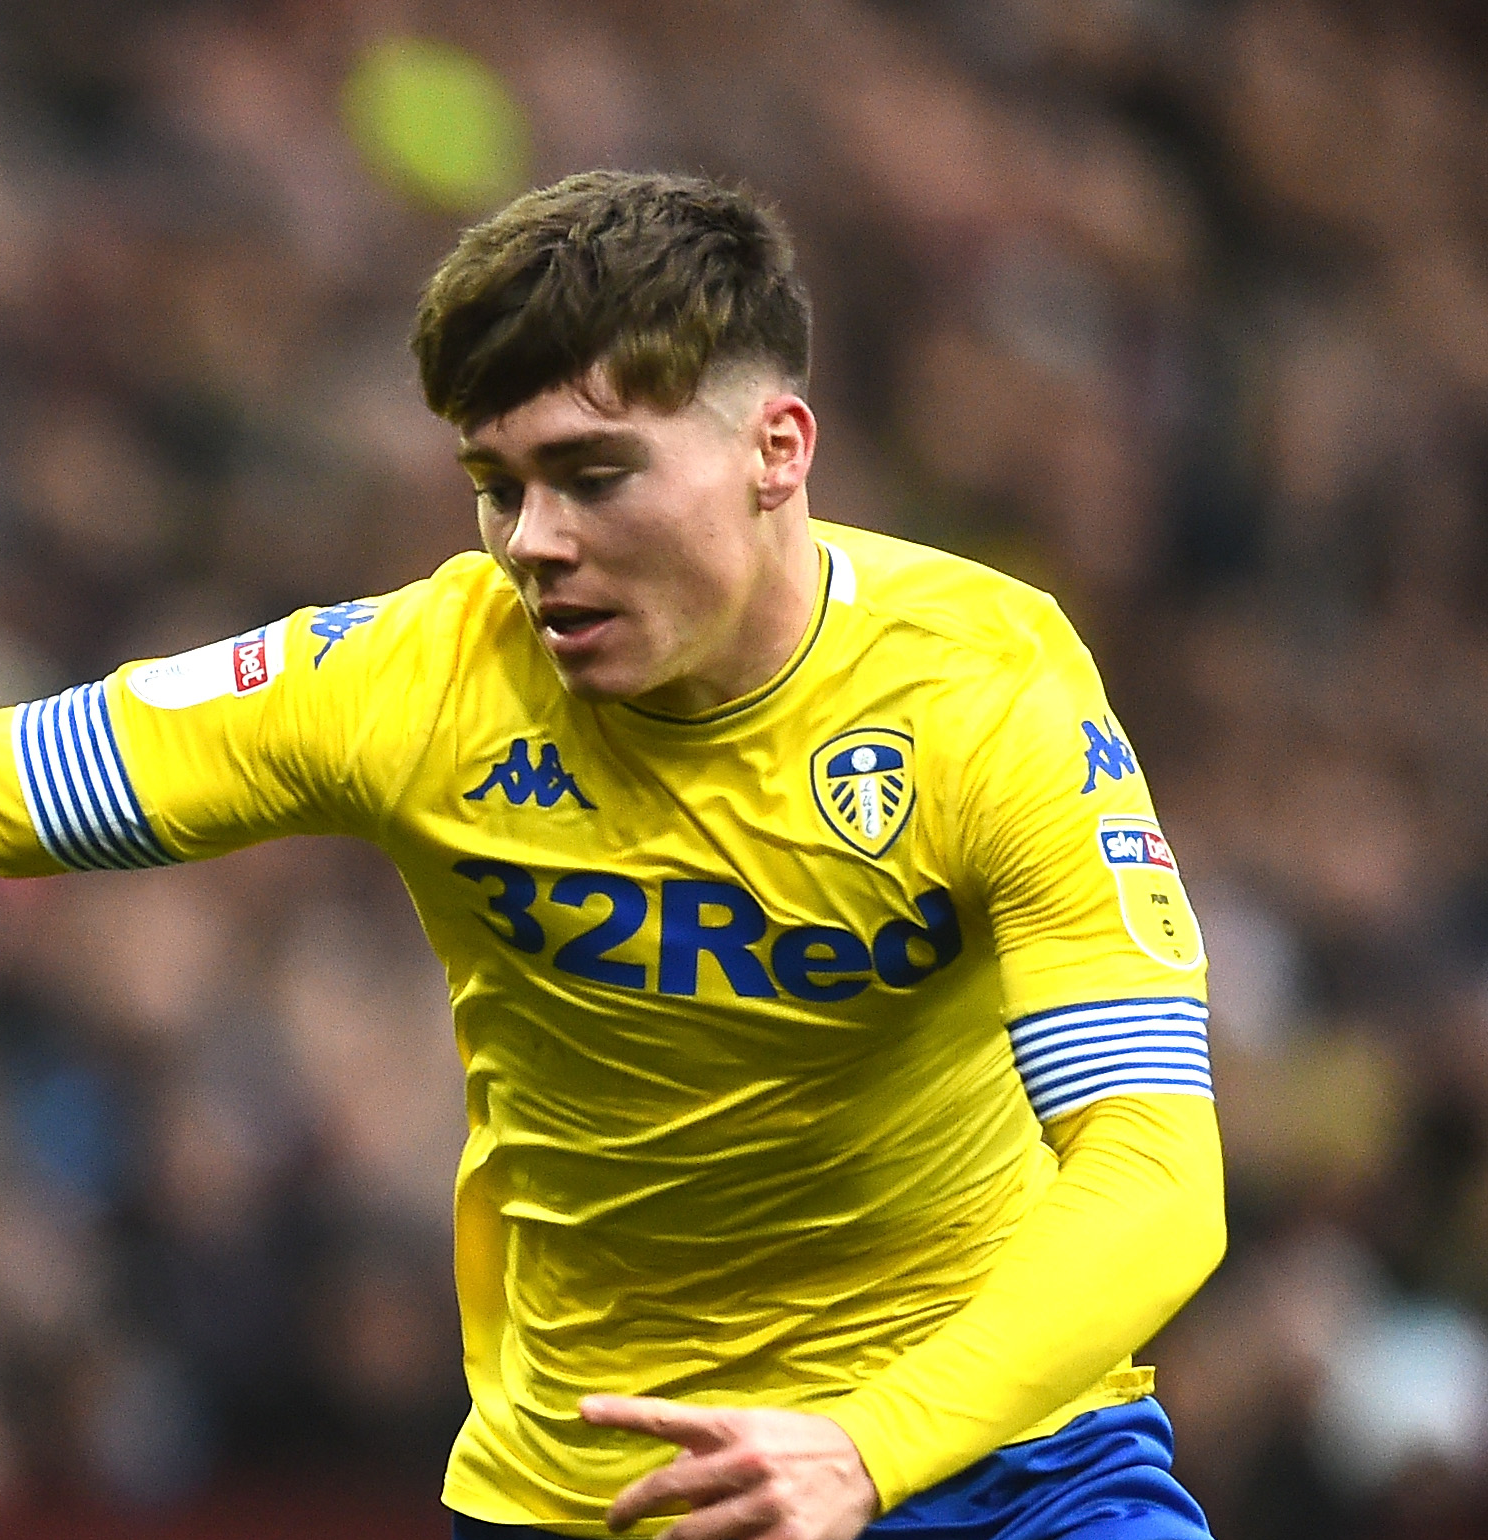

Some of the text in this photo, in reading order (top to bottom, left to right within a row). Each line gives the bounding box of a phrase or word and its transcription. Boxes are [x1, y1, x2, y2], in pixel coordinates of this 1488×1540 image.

[238, 641, 265, 687] bet
[1106, 831, 1143, 862] sky
[452, 858, 963, 1003] 32Red
